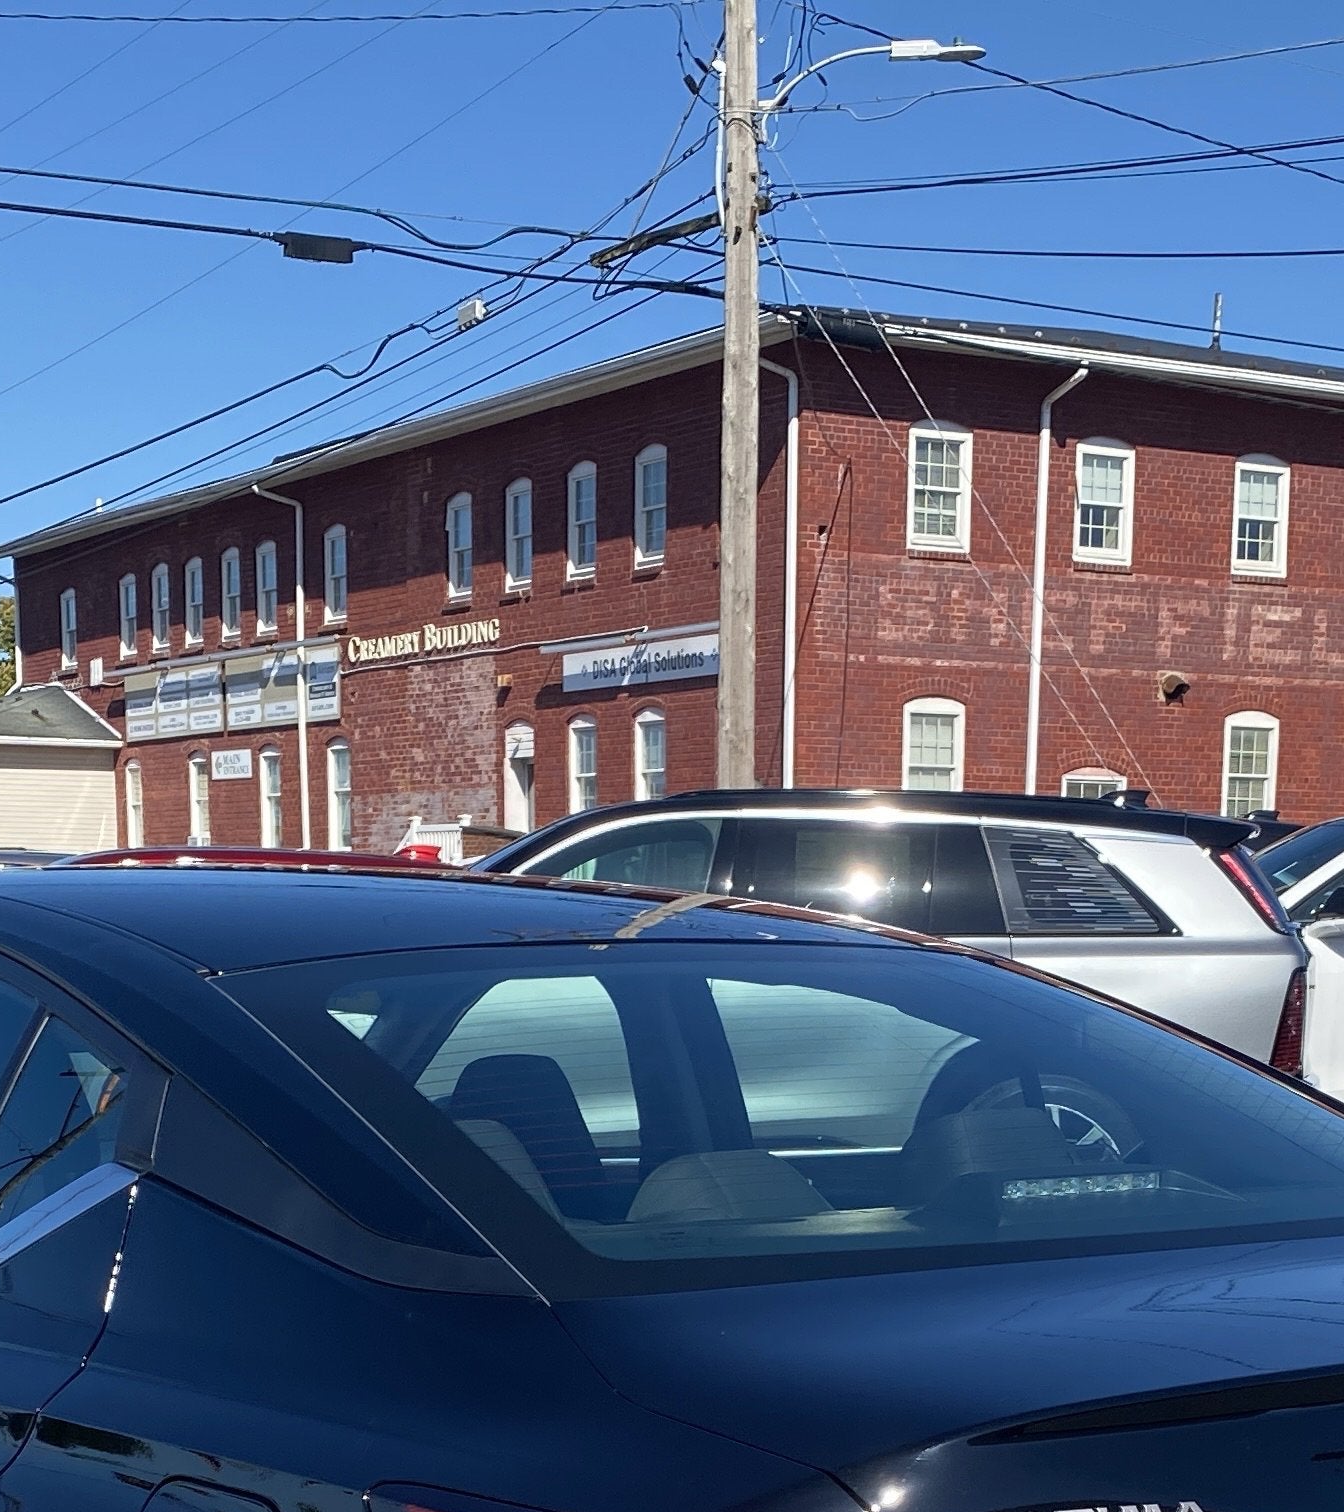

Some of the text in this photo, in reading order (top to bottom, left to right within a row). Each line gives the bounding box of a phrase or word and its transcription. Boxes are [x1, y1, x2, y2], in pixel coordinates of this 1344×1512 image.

[592, 648, 704, 679] DISA Global Solutions
